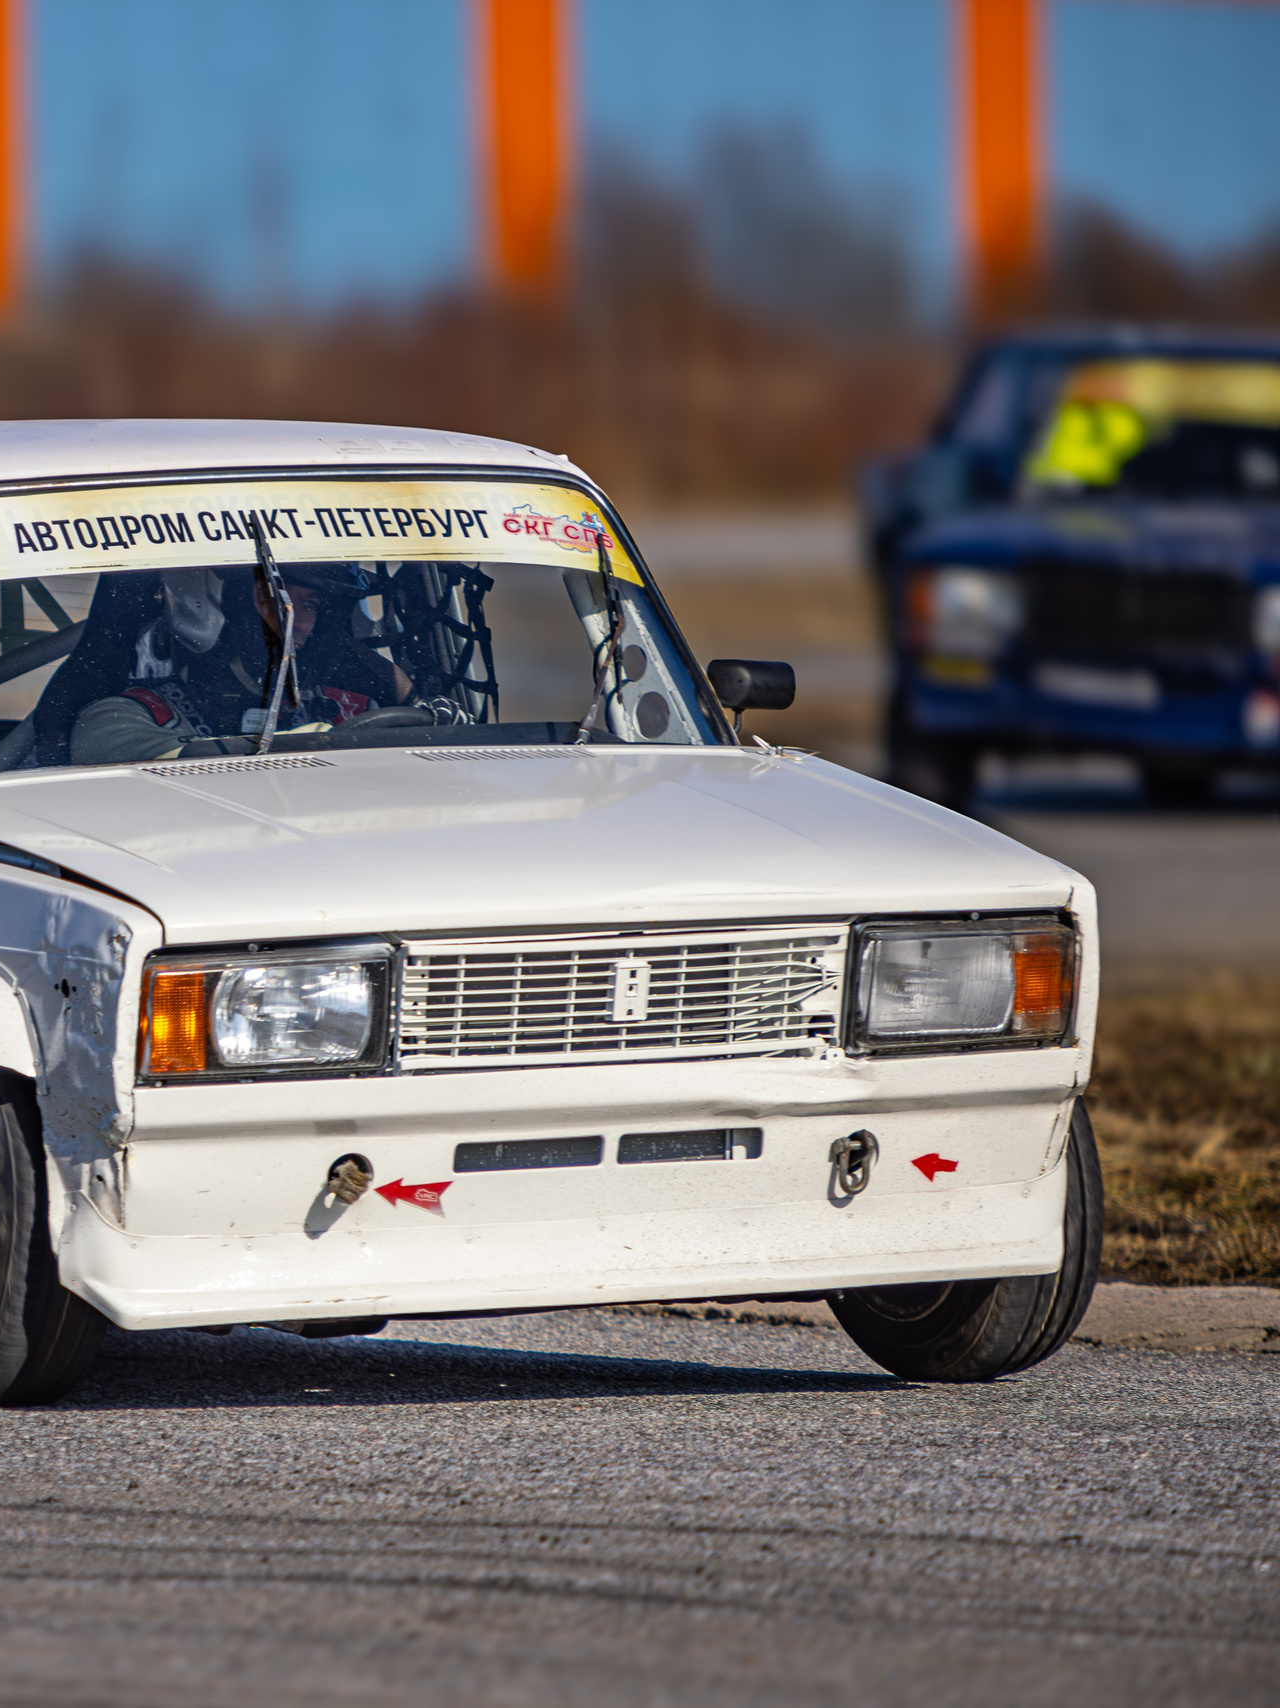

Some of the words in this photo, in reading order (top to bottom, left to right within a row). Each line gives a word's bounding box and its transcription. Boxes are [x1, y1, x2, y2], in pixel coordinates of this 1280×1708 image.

[14, 512, 195, 553] АВТОДРОМ
[197, 507, 489, 541] САНКТ-ПЕТЕРБУРГ
[503, 518, 554, 536] СКГ
[564, 524, 614, 549] СПБ
